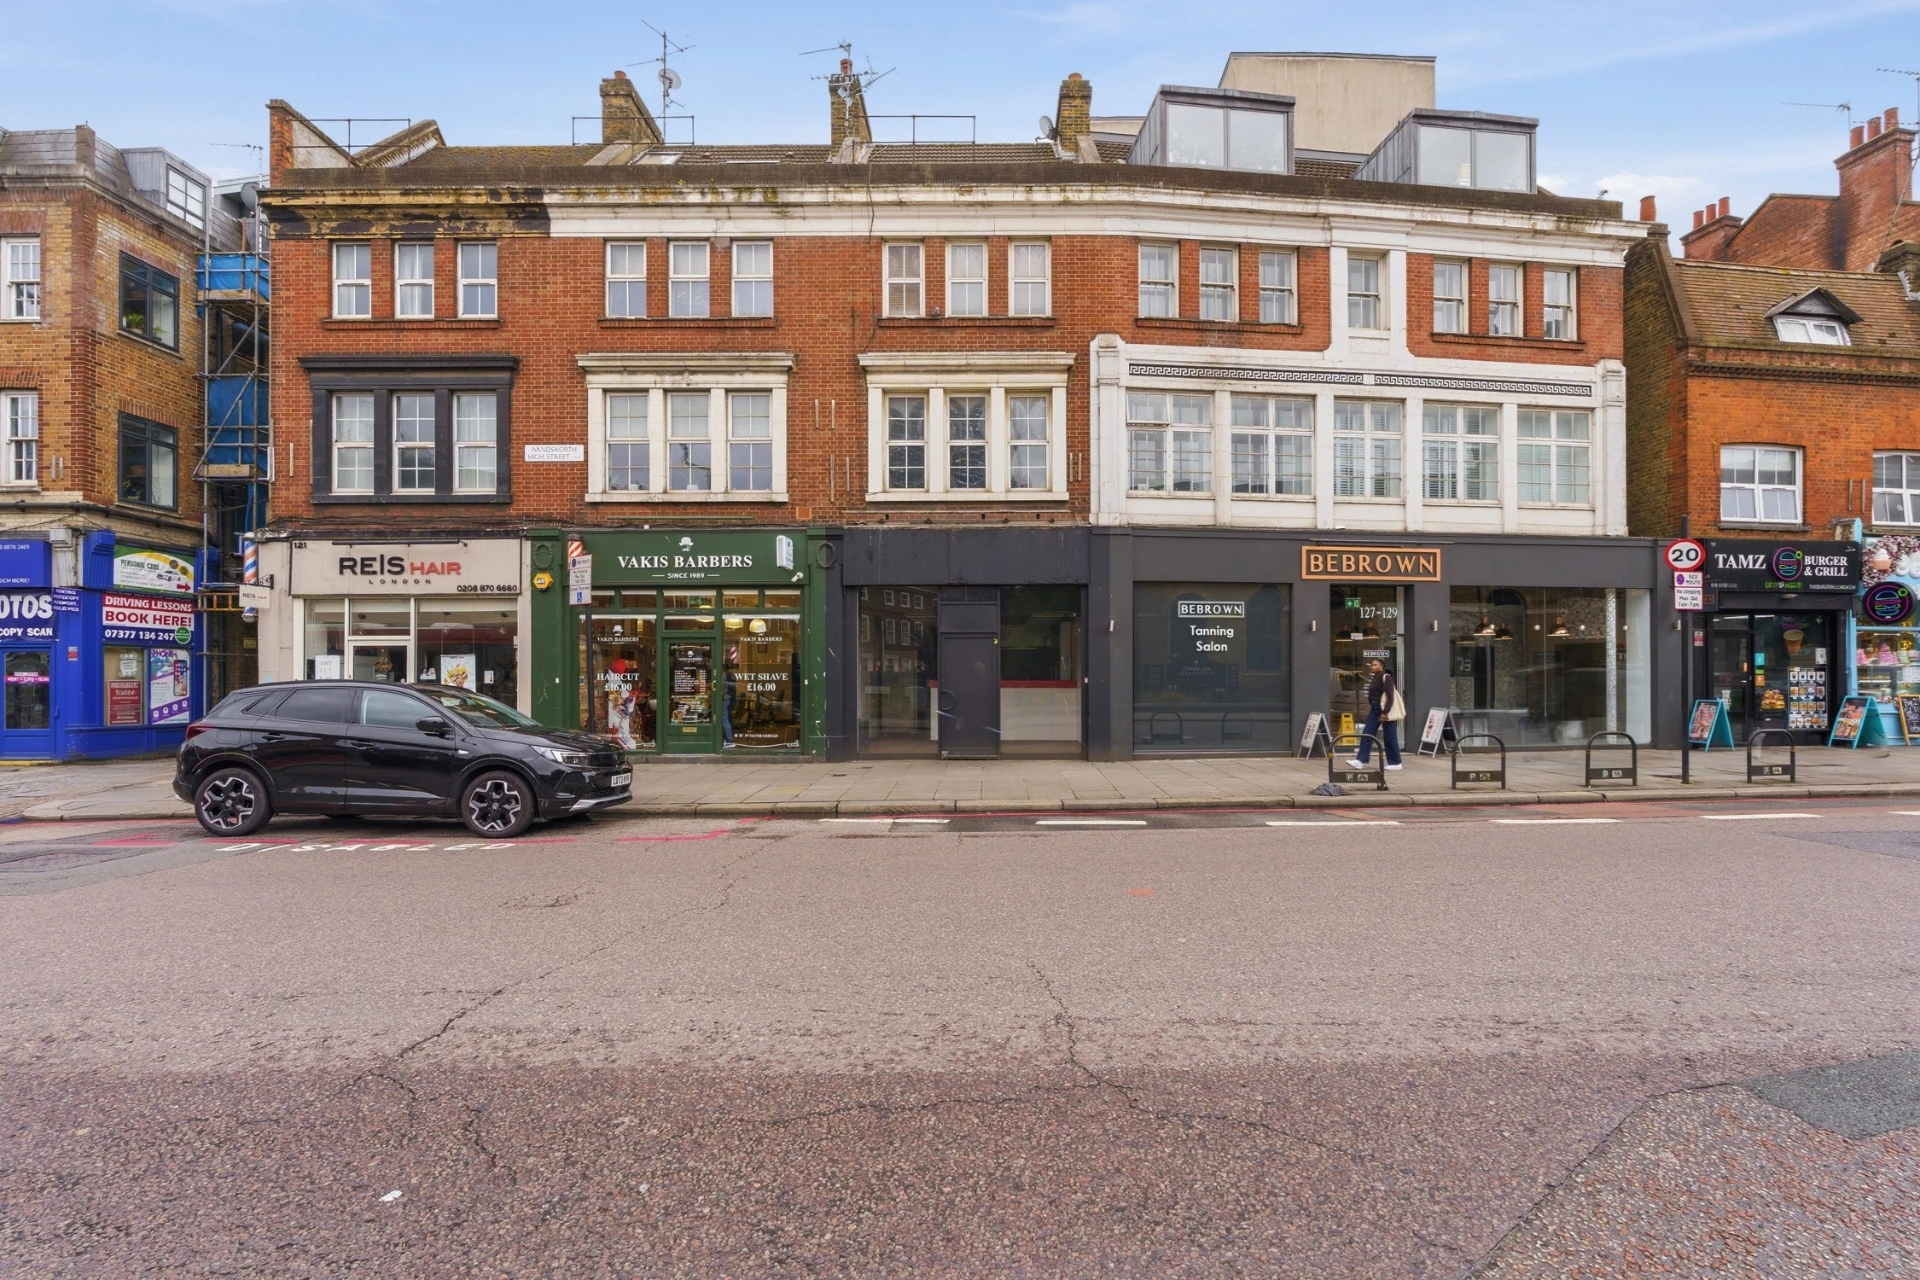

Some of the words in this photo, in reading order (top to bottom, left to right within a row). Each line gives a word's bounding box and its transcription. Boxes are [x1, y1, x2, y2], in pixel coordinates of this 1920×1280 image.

[1672, 548, 1699, 562] 20
[339, 554, 405, 575] REIS
[410, 562, 462, 575] HAIR
[618, 556, 668, 568] VAKIS
[674, 555, 752, 568] BARBERS
[1310, 554, 1434, 574] BEBROWN
[1714, 554, 1766, 570] TAMZ
[1804, 556, 1848, 566] BURGER
[1804, 568, 1812, 576] &
[1815, 567, 1848, 576] GRILL
[105, 596, 150, 608] DRIVING
[152, 600, 192, 612] LESSONS
[1181, 604, 1242, 614] BEBROWN
[106, 610, 149, 624] BOOK
[152, 614, 192, 627] HERE!
[27, 628, 53, 636] SCAN
[105, 629, 136, 638] 07377
[1190, 625, 1234, 638] Tanning
[1196, 641, 1228, 651] Salon
[597, 672, 640, 680] HAIRCUT
[734, 672, 756, 680] WET
[758, 672, 788, 680] SHAVE
[604, 683, 632, 692] £16.00
[747, 682, 776, 692] £16.00
[214, 844, 516, 852] DISABLED
